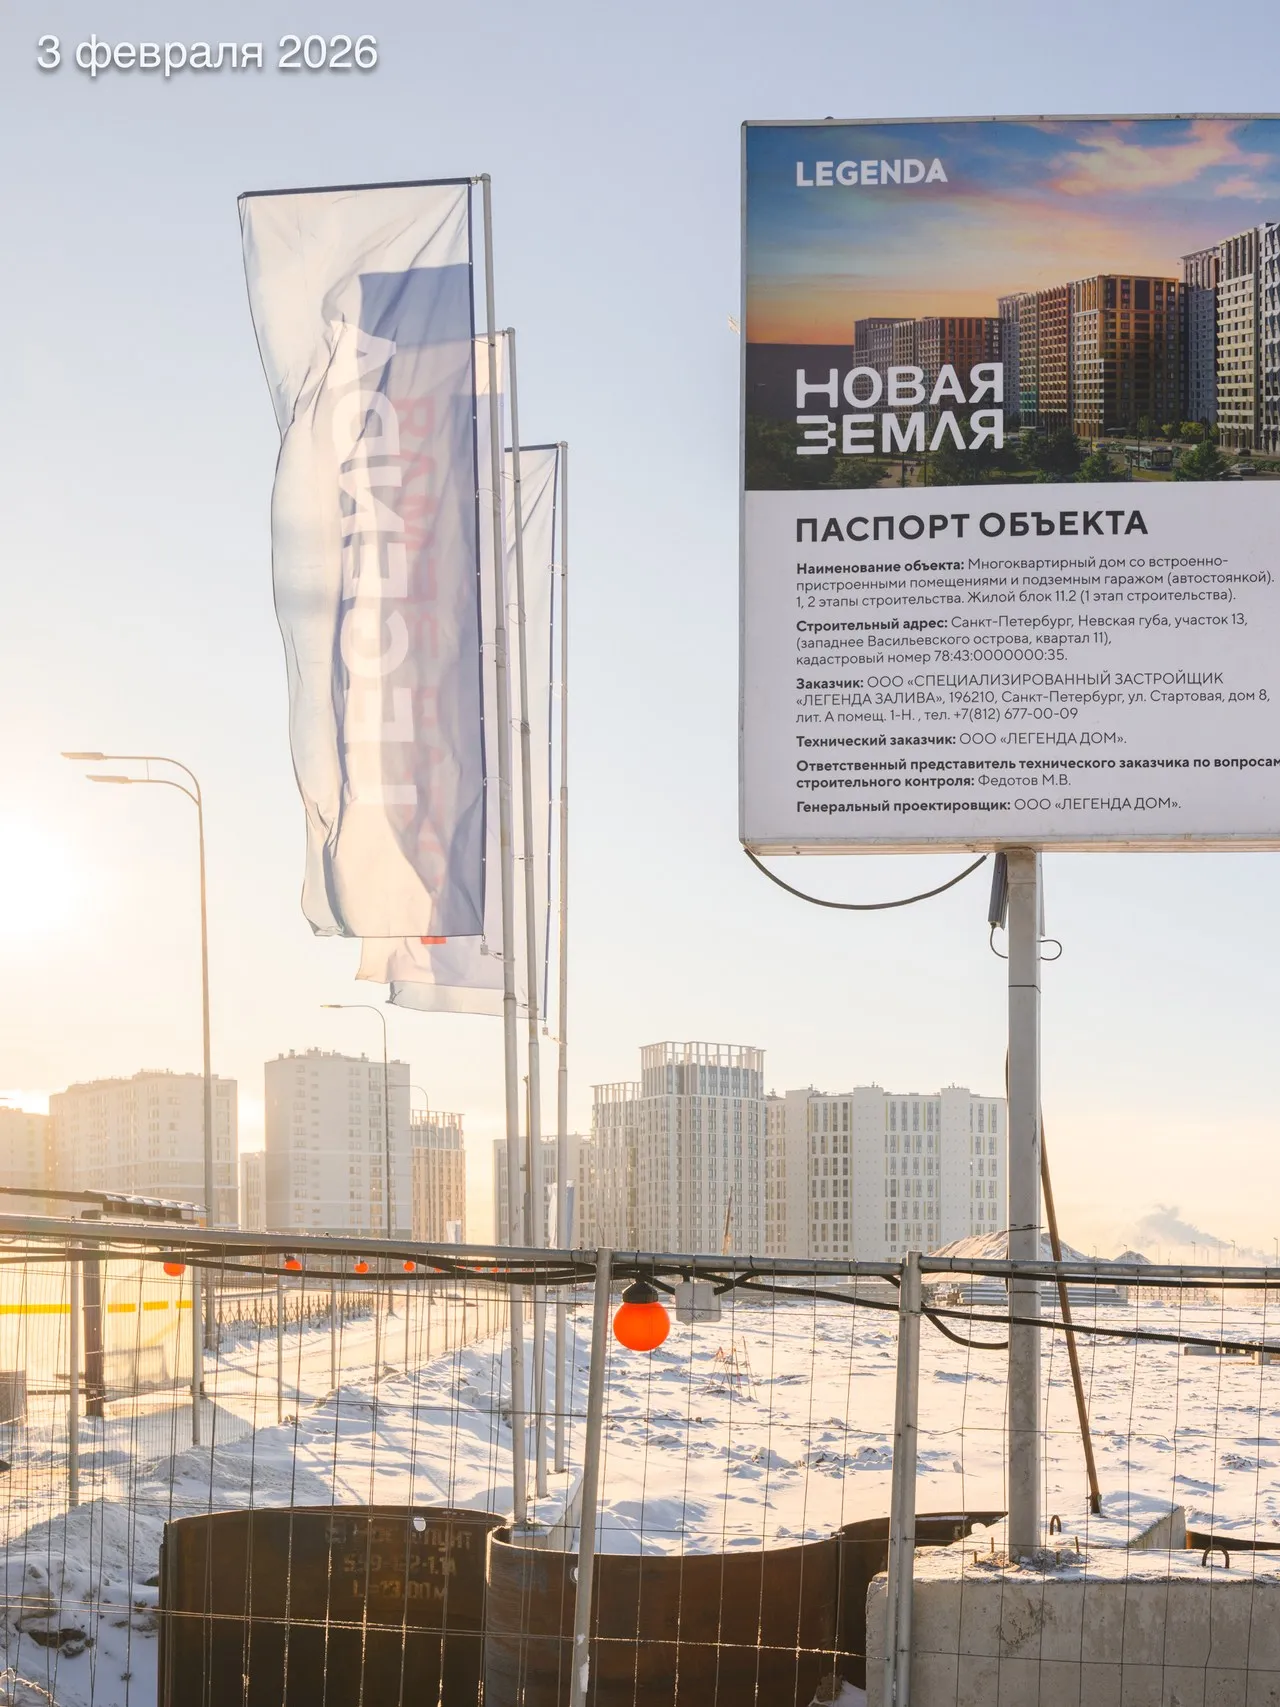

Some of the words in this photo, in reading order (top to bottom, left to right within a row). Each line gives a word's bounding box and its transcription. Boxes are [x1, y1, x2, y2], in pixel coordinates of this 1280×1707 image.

[796, 158, 948, 187] LEGENDA
[796, 362, 1004, 409] НОВАЯ
[796, 408, 1004, 455] ЗЕМЛЯ
[796, 513, 970, 543] ПАСПОРТ
[978, 509, 1149, 538] ОБЪЕКТА
[796, 562, 902, 575] Наименование
[903, 559, 965, 572] объекта:
[968, 555, 1096, 571] Многоквартирный
[1098, 558, 1126, 569] дом
[1128, 558, 1146, 568] со
[1148, 557, 1228, 570] встроенно-
[796, 579, 906, 594] пристроенными
[909, 576, 1007, 589] помещениями
[1010, 576, 1019, 585] и
[1022, 575, 1101, 587] подземным
[1104, 574, 1164, 587] гаражом
[1167, 569, 1275, 587] (автостоянкой).
[795, 595, 804, 609] 1,
[807, 595, 816, 608] 2
[818, 597, 859, 608] этапы
[861, 594, 965, 609] строительства.
[967, 590, 1016, 603] Жилой
[1018, 589, 1052, 602] блок
[1054, 589, 1077, 602] 11.2
[1079, 589, 1090, 605] (1
[1092, 592, 1124, 602] этап
[1126, 587, 1236, 604] строительства).
[795, 617, 900, 635] Строительный
[902, 619, 948, 632] адрес:
[950, 614, 1074, 630] Санкт-Петербург,
[1078, 614, 1135, 627] Невская
[1138, 613, 1171, 629] губа,
[1174, 615, 1229, 629] участок
[1231, 612, 1248, 626] 13,
[796, 636, 864, 652] (западнее
[867, 634, 971, 647] Васильевского
[972, 634, 1032, 647] острова,
[1035, 634, 1090, 647] квартал
[1093, 631, 1112, 646] 11),
[796, 651, 884, 668] кадастровый
[887, 653, 931, 665] номер
[933, 648, 1068, 662] 78:43:0000000:35.
[795, 677, 864, 690] Заказчик:
[866, 675, 904, 688] ООО
[907, 669, 1111, 688] «СПЕЦИАЛИЗИРОВАННЫЙ
[1114, 669, 1224, 686] ЗАСТРОЙЩИК
[795, 692, 873, 707] «ЛЕГЕНДА
[874, 691, 946, 705] ЗАЛИВА»,
[948, 690, 998, 704] 196210,
[1001, 689, 1125, 706] Санкт-Петербург,
[1127, 692, 1147, 705] ул.
[1149, 689, 1225, 705] Стартовая,
[1227, 691, 1255, 703] дом
[1258, 688, 1270, 702] 8,
[795, 713, 822, 723] лит.
[823, 710, 835, 723] А
[837, 712, 887, 723] помещ.
[889, 708, 915, 721] 1-Н.
[923, 711, 951, 721] тел.
[953, 707, 1001, 723] +7(812)
[1003, 706, 1079, 720] 677-00-09
[795, 733, 887, 748] Технический
[889, 735, 956, 746] заказчик:
[959, 732, 997, 745] ООО
[1000, 731, 1078, 746] «ЛЕГЕНДА
[1079, 731, 1127, 746] ДОМ».
[795, 757, 907, 772] Ответственный
[910, 760, 1016, 773] представитель
[1018, 759, 1116, 769] технического
[1118, 758, 1190, 768] заказчика
[1193, 758, 1211, 768] по
[795, 777, 902, 791] строительного
[904, 777, 975, 790] контроля:
[977, 774, 1038, 787] Федотов
[1042, 773, 1071, 786] М.В.
[796, 799, 890, 815] Генеральный
[893, 801, 1011, 815] проектировщик:
[1013, 798, 1051, 811] ООО
[1054, 797, 1132, 812] «ЛЕГЕНДА
[1133, 796, 1181, 811] ДОМ».
